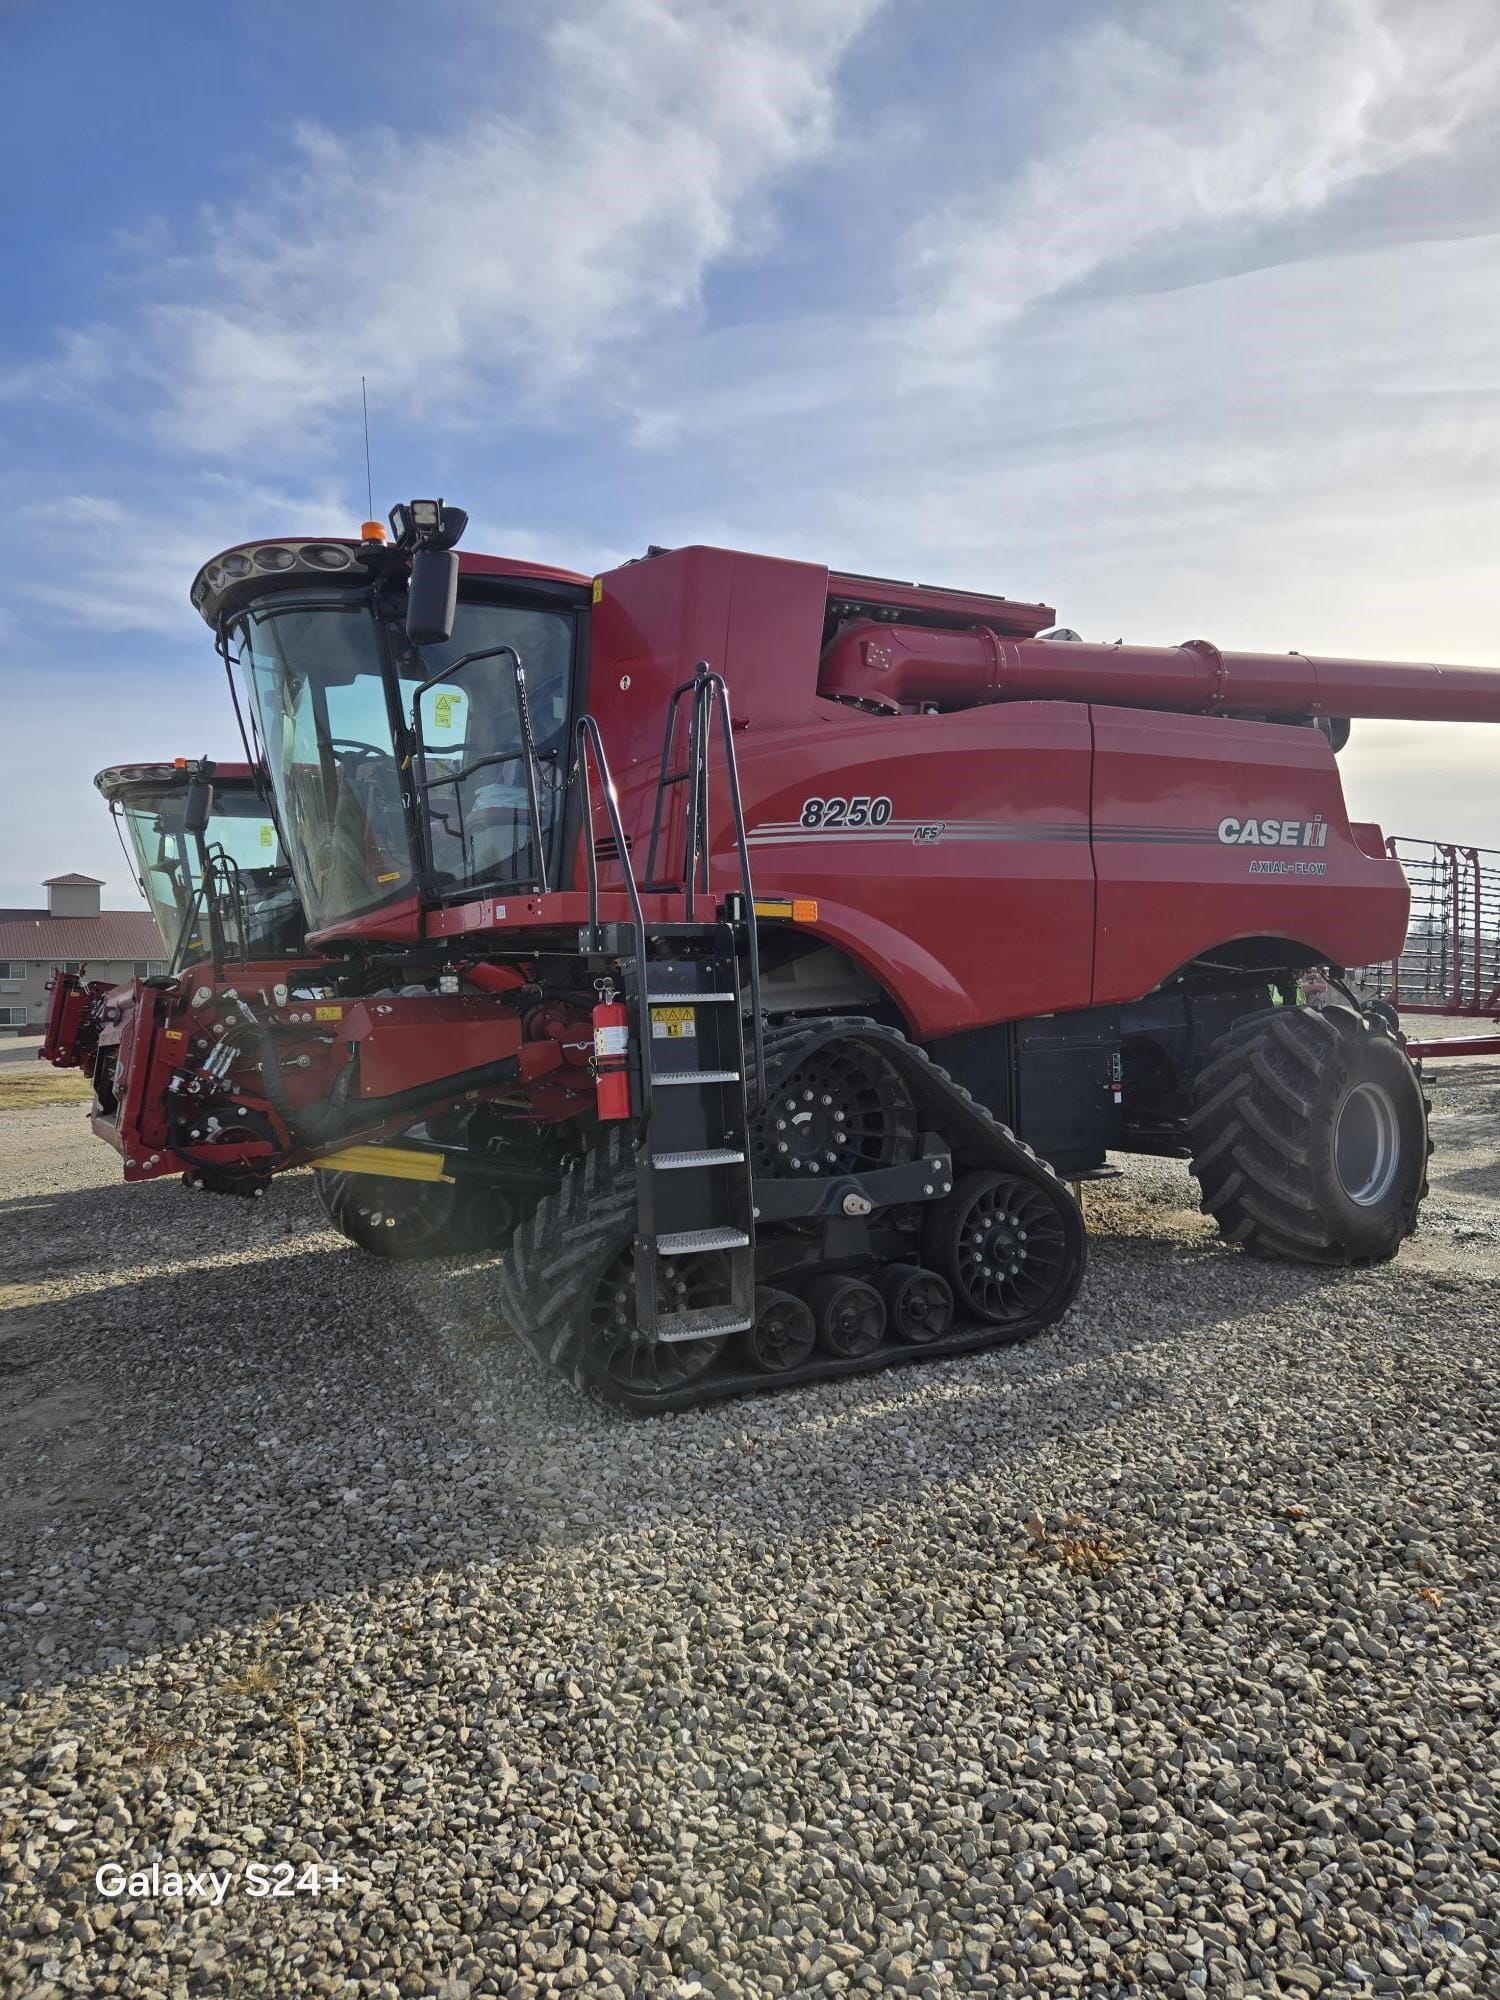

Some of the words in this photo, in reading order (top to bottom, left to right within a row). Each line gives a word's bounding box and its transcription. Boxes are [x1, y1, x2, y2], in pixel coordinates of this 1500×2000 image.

[800, 796, 892, 830] 8250
[913, 826, 939, 839] AFS
[1218, 817, 1300, 845] CASE
[1248, 861, 1326, 875] AXIAL-FLOW
